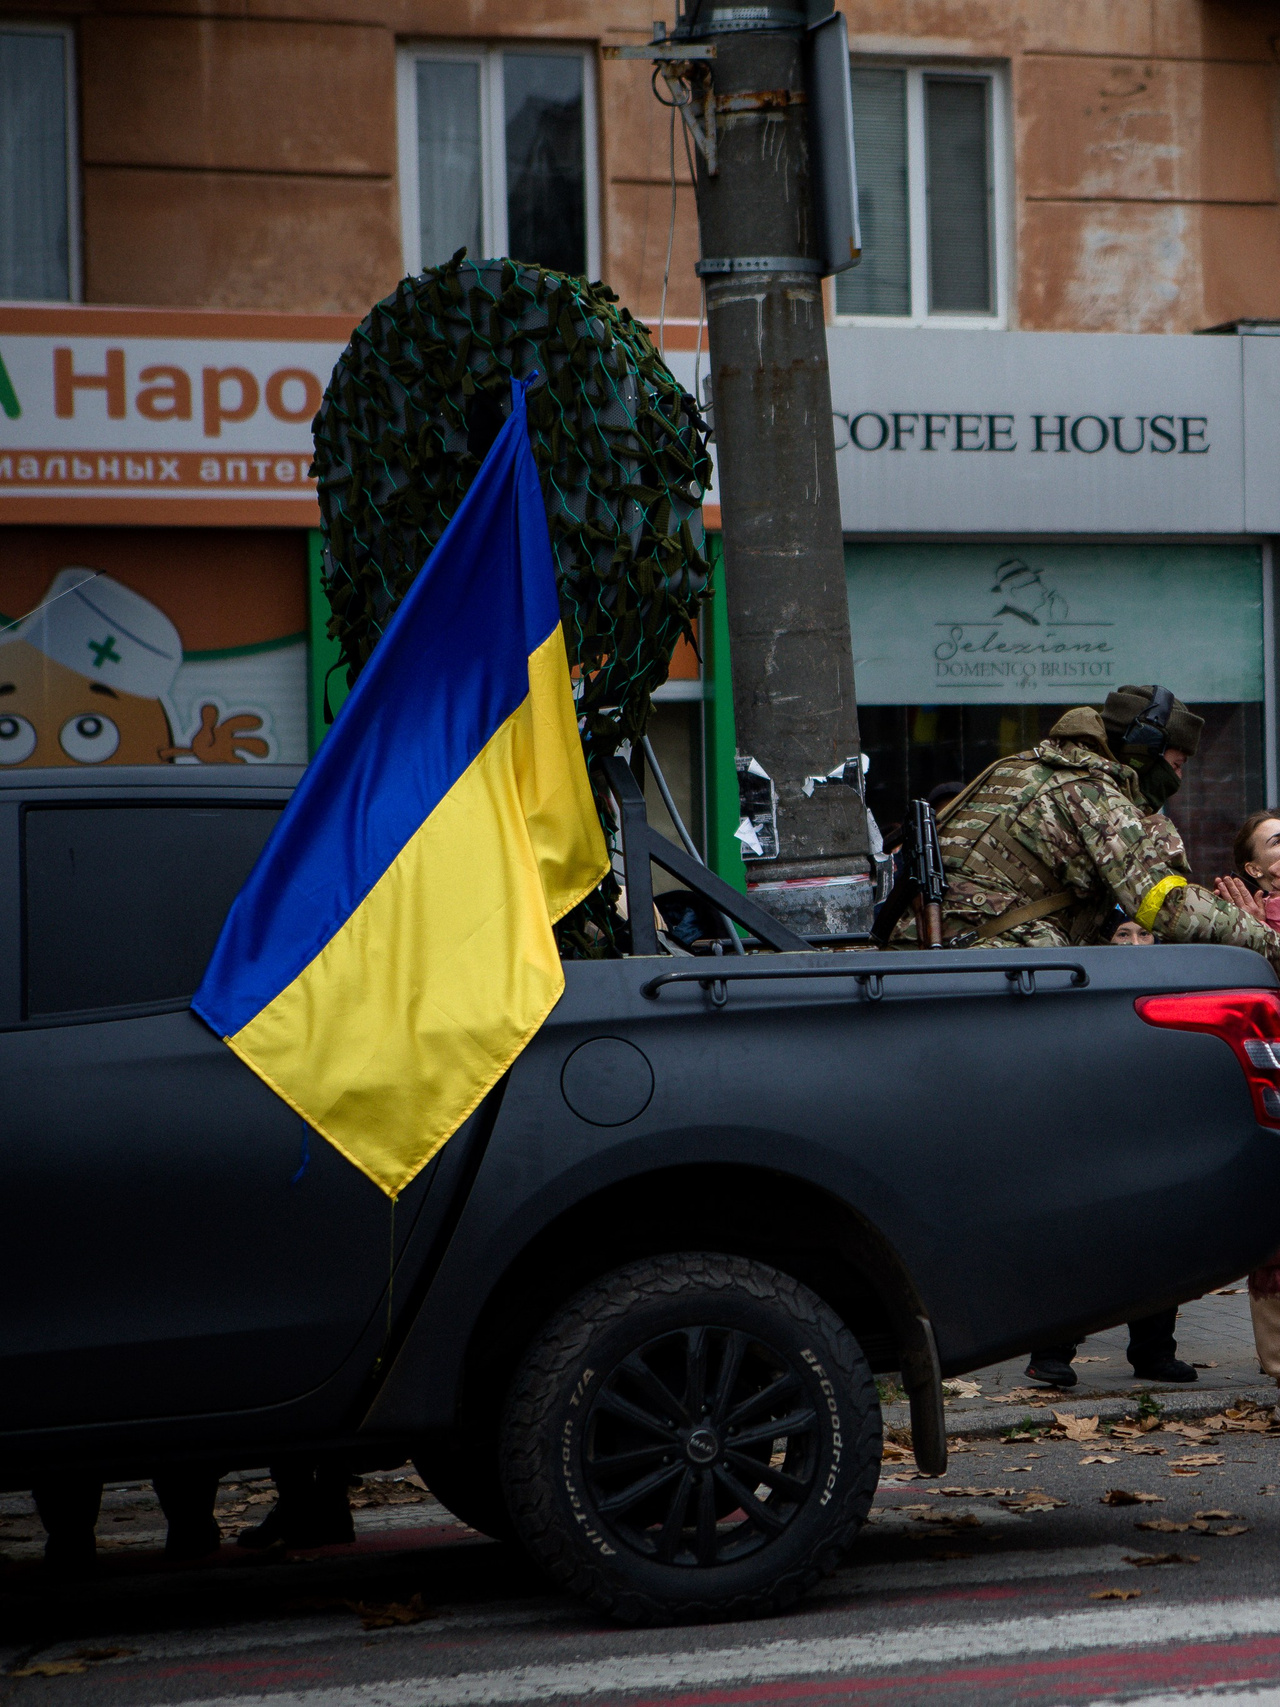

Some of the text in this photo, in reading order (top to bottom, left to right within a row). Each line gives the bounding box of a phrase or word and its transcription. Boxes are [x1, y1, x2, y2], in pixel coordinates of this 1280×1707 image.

[53, 347, 324, 438] Наро
[1029, 413, 1211, 454] HOUSE
[935, 626, 1115, 661] Selezione
[936, 661, 1115, 678] DOMENICO BRISTOT
[800, 1348, 844, 1507] BFGoodrich
